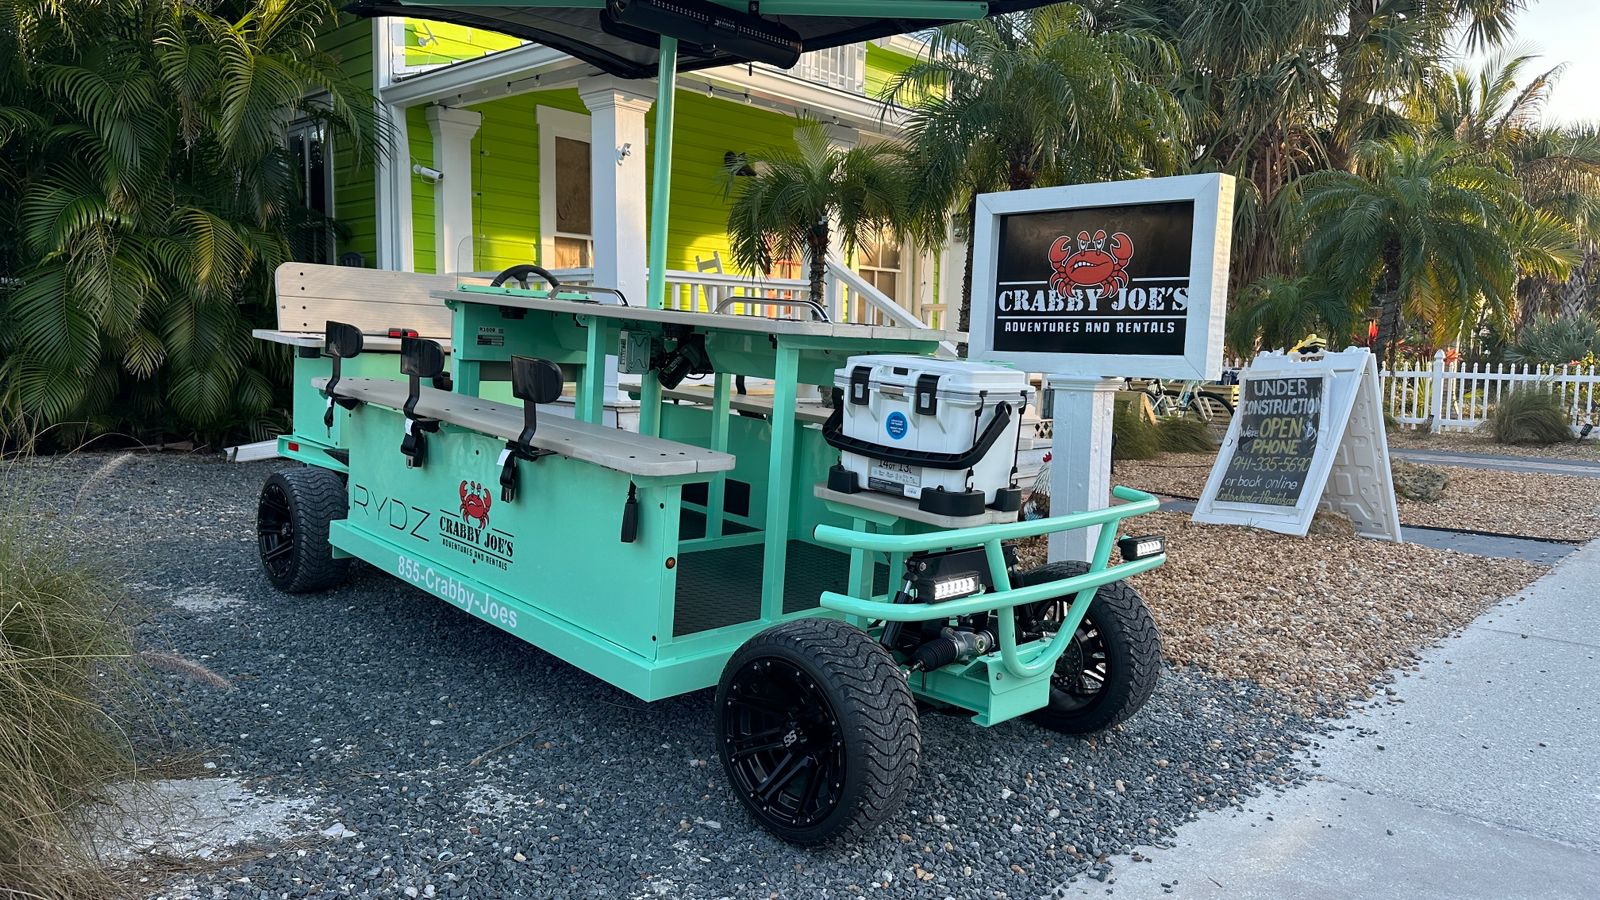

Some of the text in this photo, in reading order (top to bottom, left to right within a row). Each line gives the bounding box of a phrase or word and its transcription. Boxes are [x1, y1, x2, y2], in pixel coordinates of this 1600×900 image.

[998, 286, 1189, 312] CRABBY JOE'S
[1005, 321, 1175, 333] ADVENTURES AND RENTALS
[1253, 379, 1308, 396] UNDER
[1243, 397, 1320, 416] CONSTRUCTION
[1260, 417, 1303, 438] OPEN
[1250, 439, 1301, 454] PHONE
[1232, 456, 1312, 472] 941-335-5690
[1224, 475, 1298, 490] or book online
[353, 484, 431, 542] RYDZ
[439, 516, 514, 558] CRABBY JOE'S
[442, 538, 508, 571] ADVENTURES AND RENTALS
[398, 556, 518, 628] 855-Crabby-Joes
